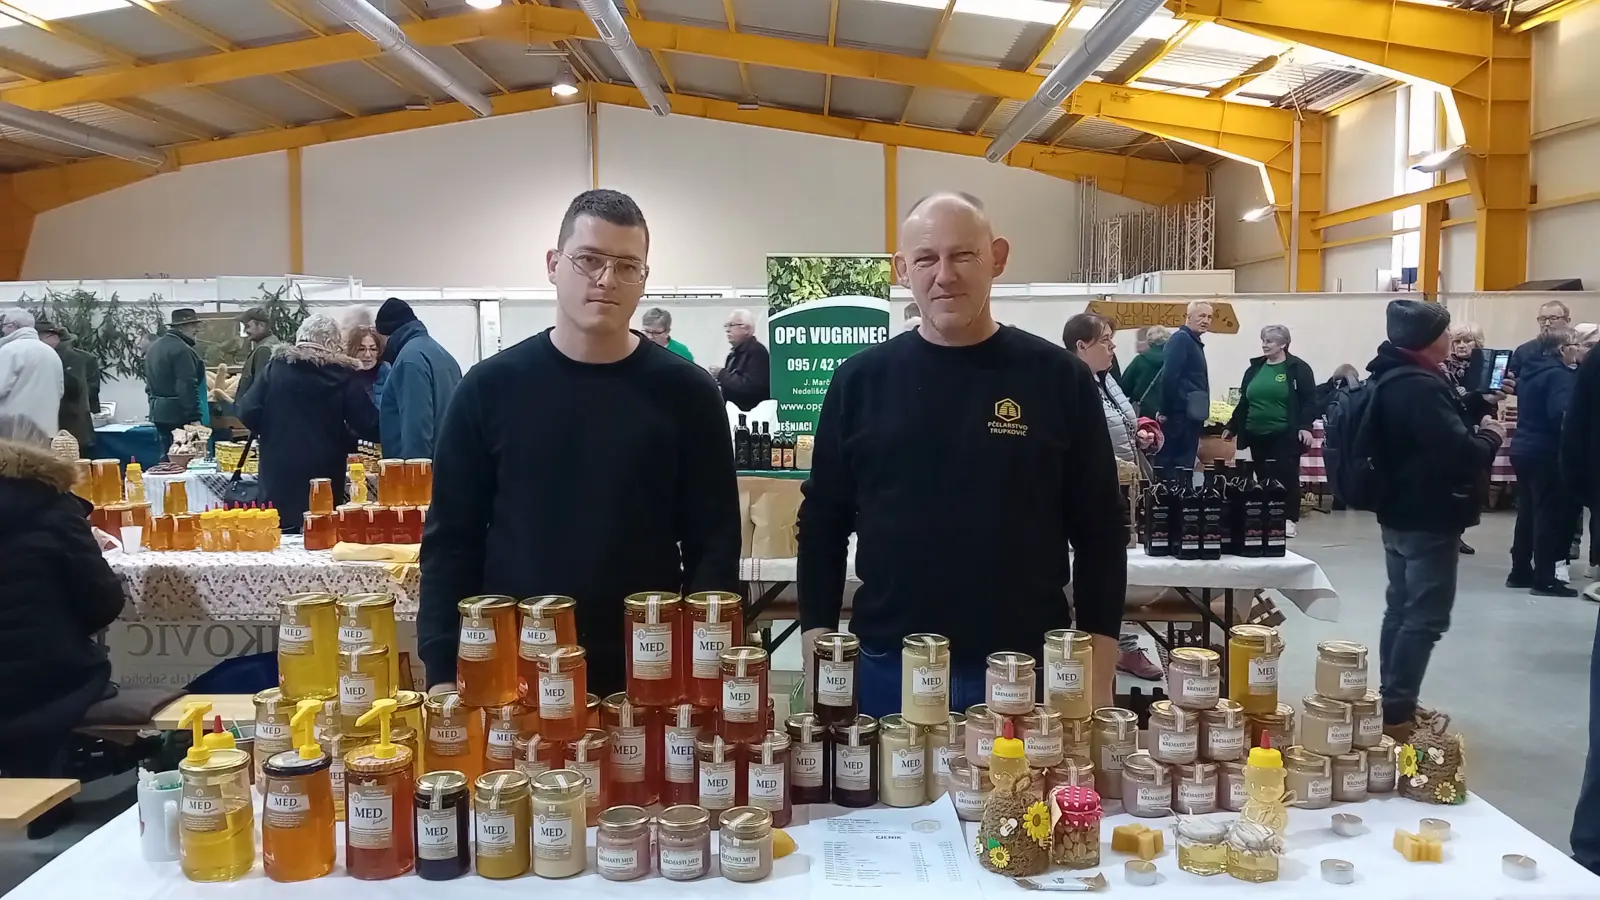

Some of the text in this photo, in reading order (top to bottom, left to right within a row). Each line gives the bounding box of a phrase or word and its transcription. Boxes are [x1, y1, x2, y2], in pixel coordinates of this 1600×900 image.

[774, 326, 888, 345] OPG VUGRINEC
[787, 358, 810, 371] 095
[812, 358, 818, 371] /
[819, 358, 834, 371] 42
[812, 378, 831, 386] Marč
[780, 403, 823, 412] www.opg
[987, 421, 1029, 431] PČELARSTVO
[284, 628, 302, 637] MED
[343, 630, 363, 638] MED
[466, 631, 486, 640] MED
[527, 631, 547, 640] MED
[640, 642, 665, 652] MED
[699, 641, 725, 651] MED
[826, 676, 847, 685] MED
[1056, 672, 1077, 681] MED
[921, 677, 942, 686] MED
[345, 687, 366, 695] MED
[545, 688, 565, 697] MED
[730, 691, 751, 701] MED
[262, 726, 281, 735] MED
[437, 730, 458, 738] MED
[613, 744, 638, 755] MED
[797, 757, 817, 766] MED
[1111, 754, 1123, 763] ME
[843, 760, 864, 770] MED
[901, 759, 921, 768] MED
[707, 778, 729, 788] MED
[756, 779, 778, 790] MED
[189, 800, 212, 810] MED
[274, 797, 298, 807] MED
[355, 806, 383, 819] MED
[425, 826, 449, 836] MED
[483, 825, 505, 835] MED
[541, 826, 563, 836] MED
